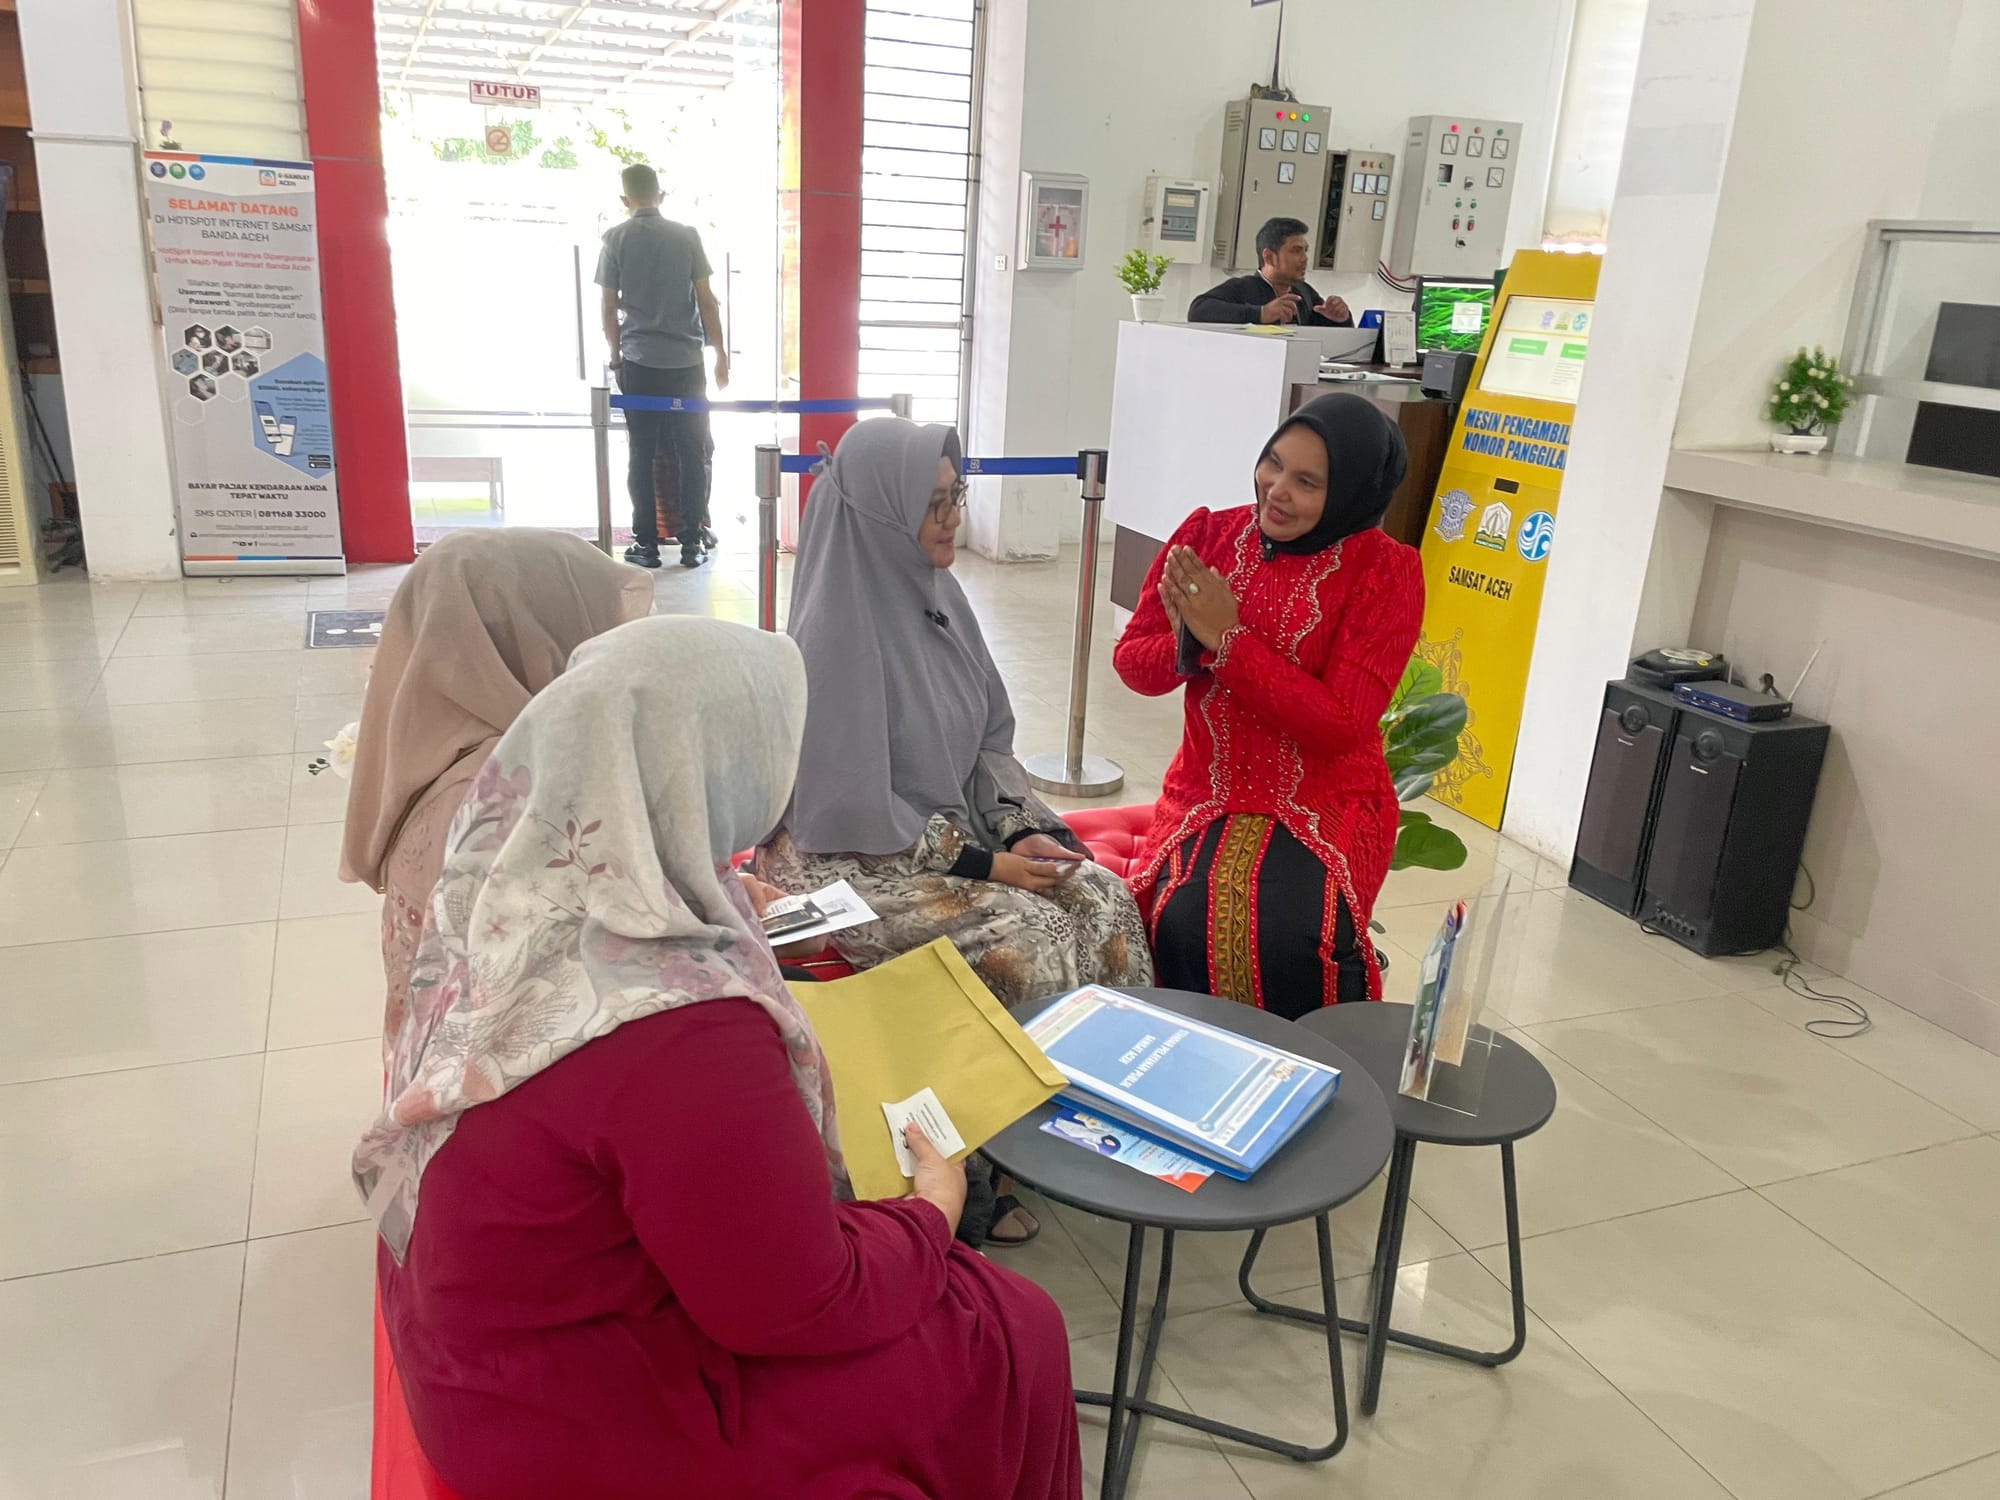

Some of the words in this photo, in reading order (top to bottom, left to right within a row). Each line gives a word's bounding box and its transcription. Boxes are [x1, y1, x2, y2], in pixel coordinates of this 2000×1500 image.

[473, 83, 538, 99] TUTUP
[167, 197, 238, 213] SELAMAT
[240, 202, 299, 218] DATANG
[154, 214, 165, 224] DI
[167, 215, 217, 227] HOTSPOT
[219, 218, 270, 231] INTERNET
[271, 221, 313, 233] SAMSAT
[201, 229, 240, 241] BANDA
[240, 232, 270, 243] ACEH
[1464, 407, 1502, 433] MESIN
[1462, 431, 1506, 458] NOMOR
[188, 482, 218, 490] BAYAR
[218, 483, 248, 491] PAJAK
[229, 492, 257, 500] TEPAT
[194, 509, 216, 518] SMS
[216, 509, 253, 518] CENTER
[1448, 565, 1486, 592] SAMSAT
[1484, 576, 1513, 601] ACEH
